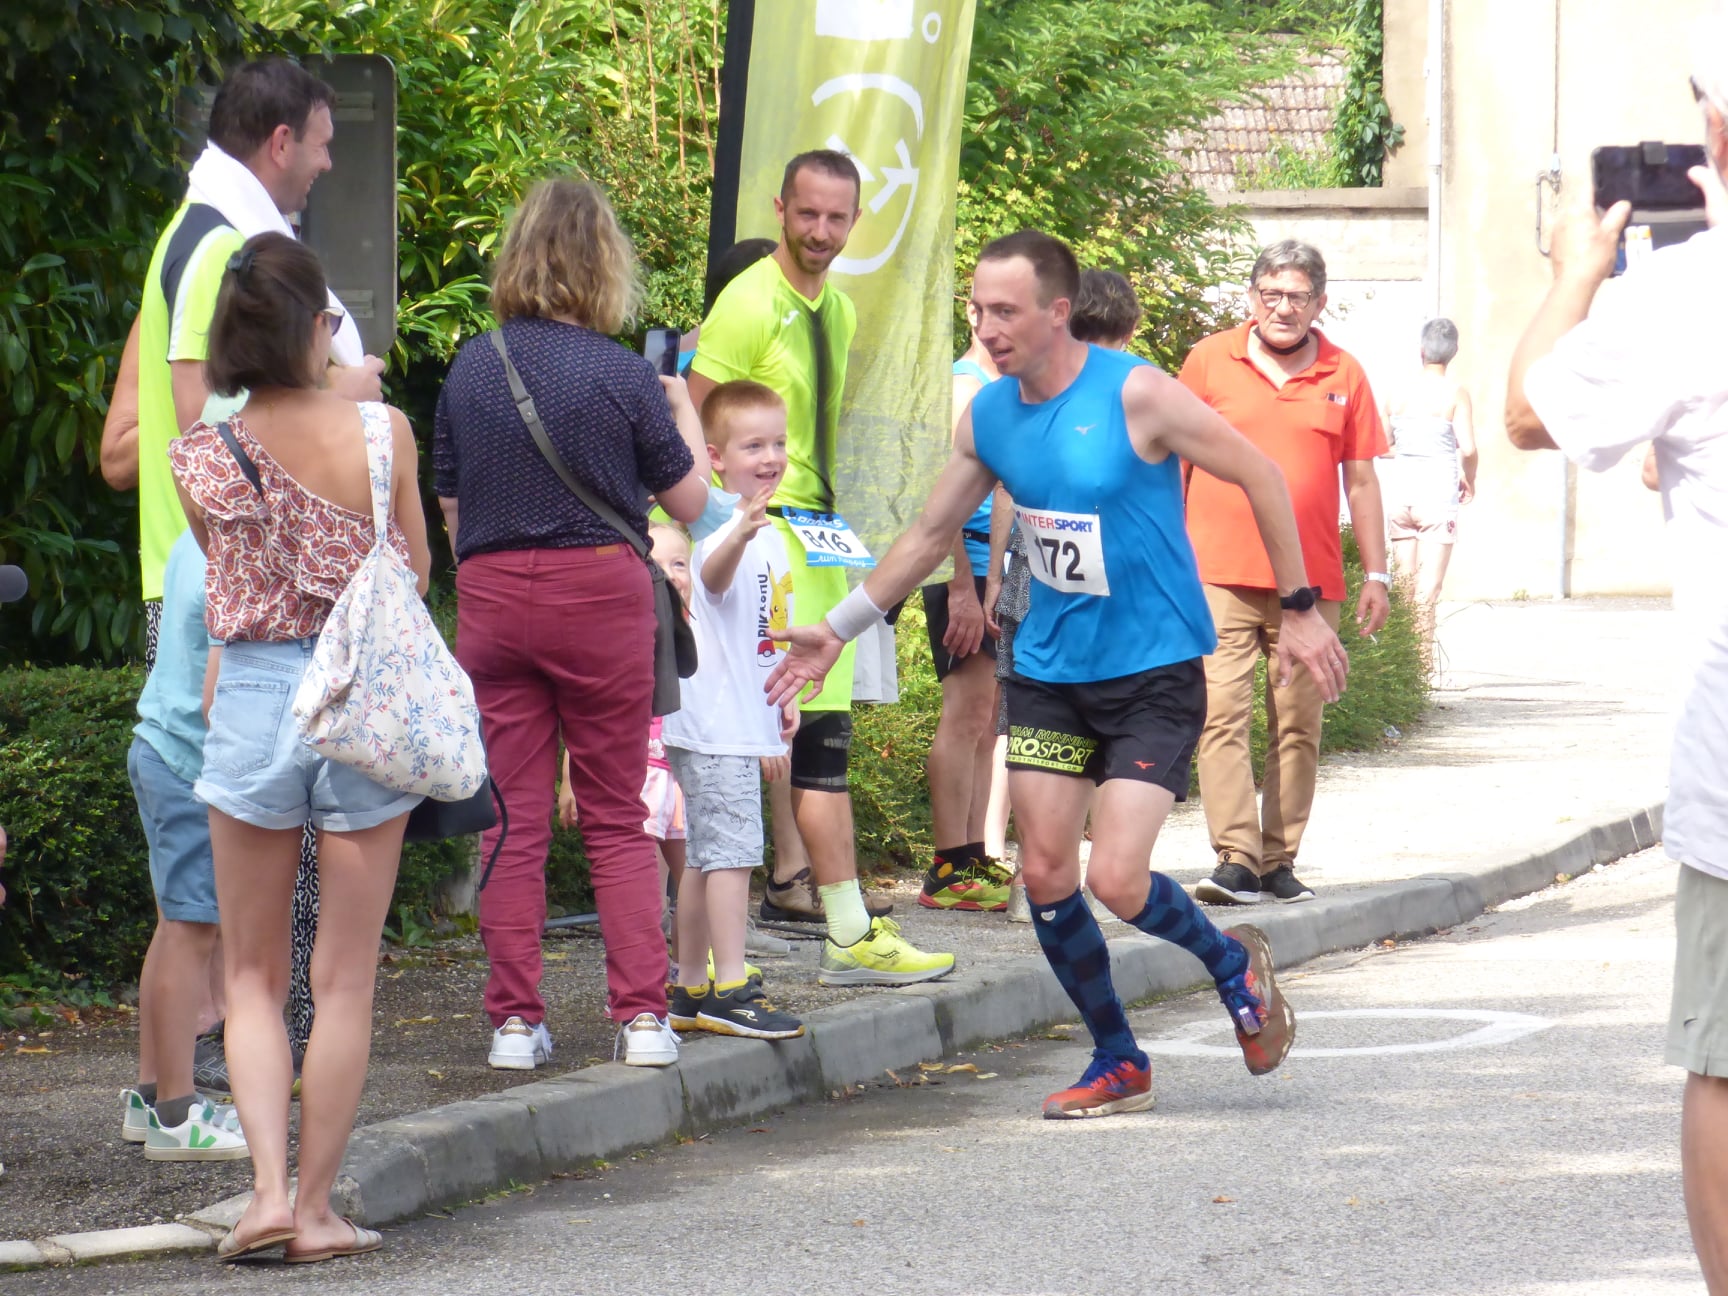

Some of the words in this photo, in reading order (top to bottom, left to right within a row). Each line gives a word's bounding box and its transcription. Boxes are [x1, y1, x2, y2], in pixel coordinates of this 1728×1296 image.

[1021, 512, 1093, 532] INTERSPORT
[801, 530, 853, 553] 816
[1033, 535, 1085, 582] 172
